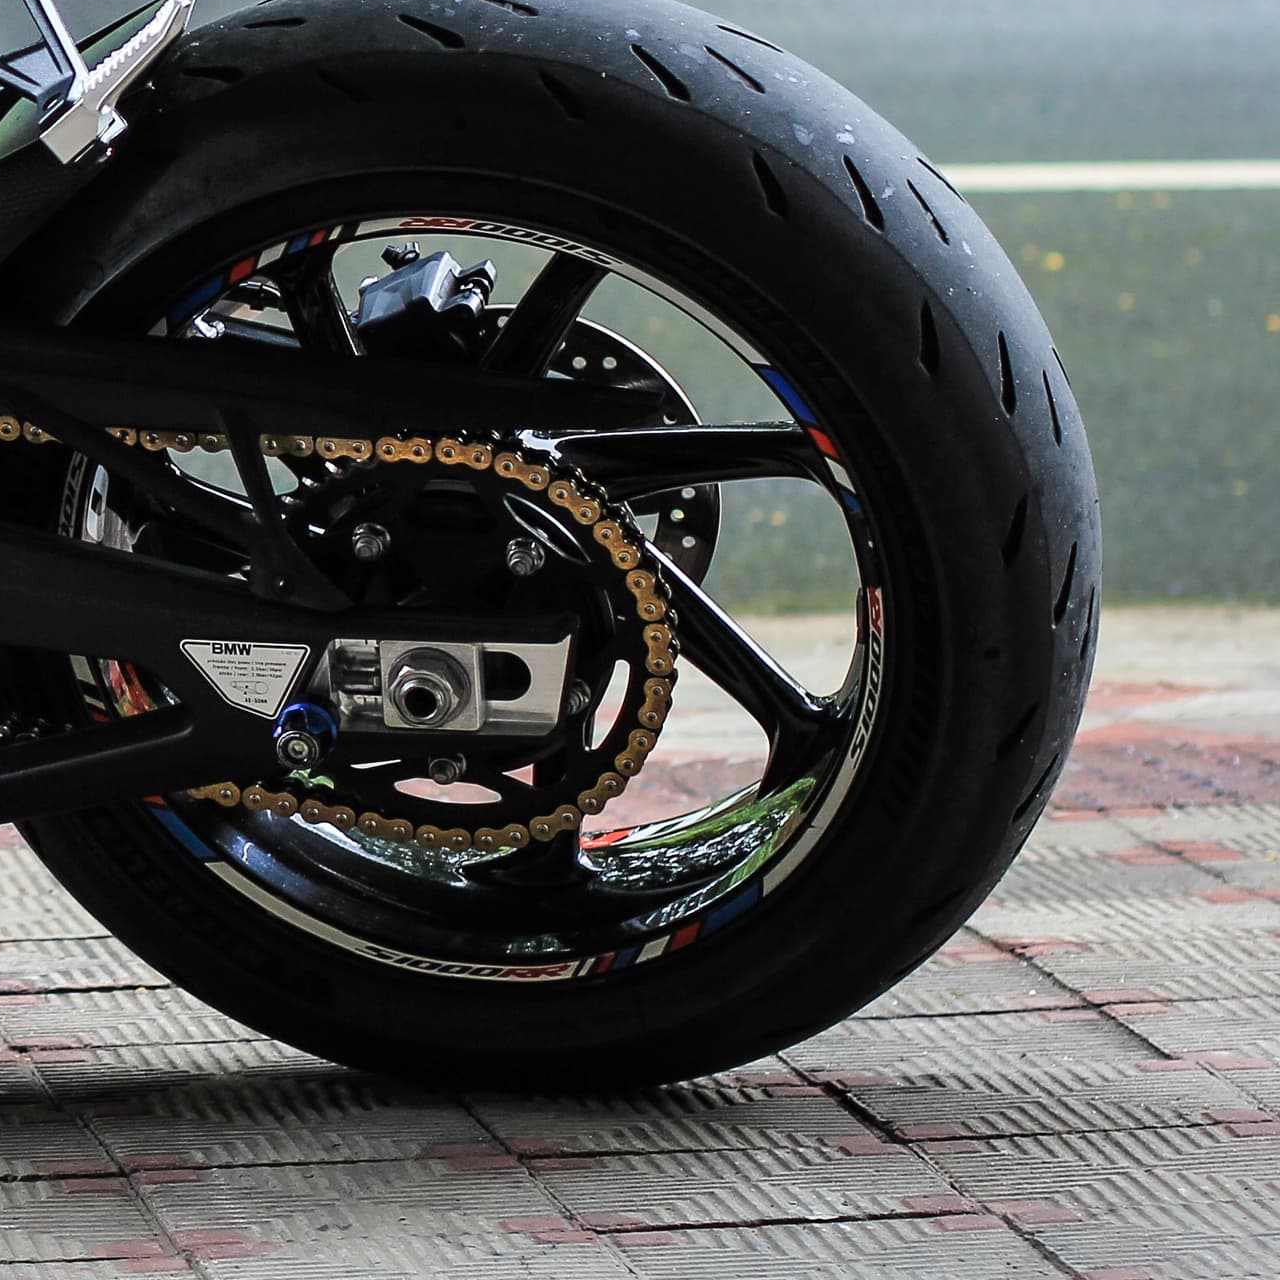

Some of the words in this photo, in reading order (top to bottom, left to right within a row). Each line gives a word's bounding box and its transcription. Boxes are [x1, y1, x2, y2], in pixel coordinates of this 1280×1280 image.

[399, 217, 623, 265] S1000RR
[212, 642, 252, 656] BMW
[356, 945, 570, 978] S1000RR
